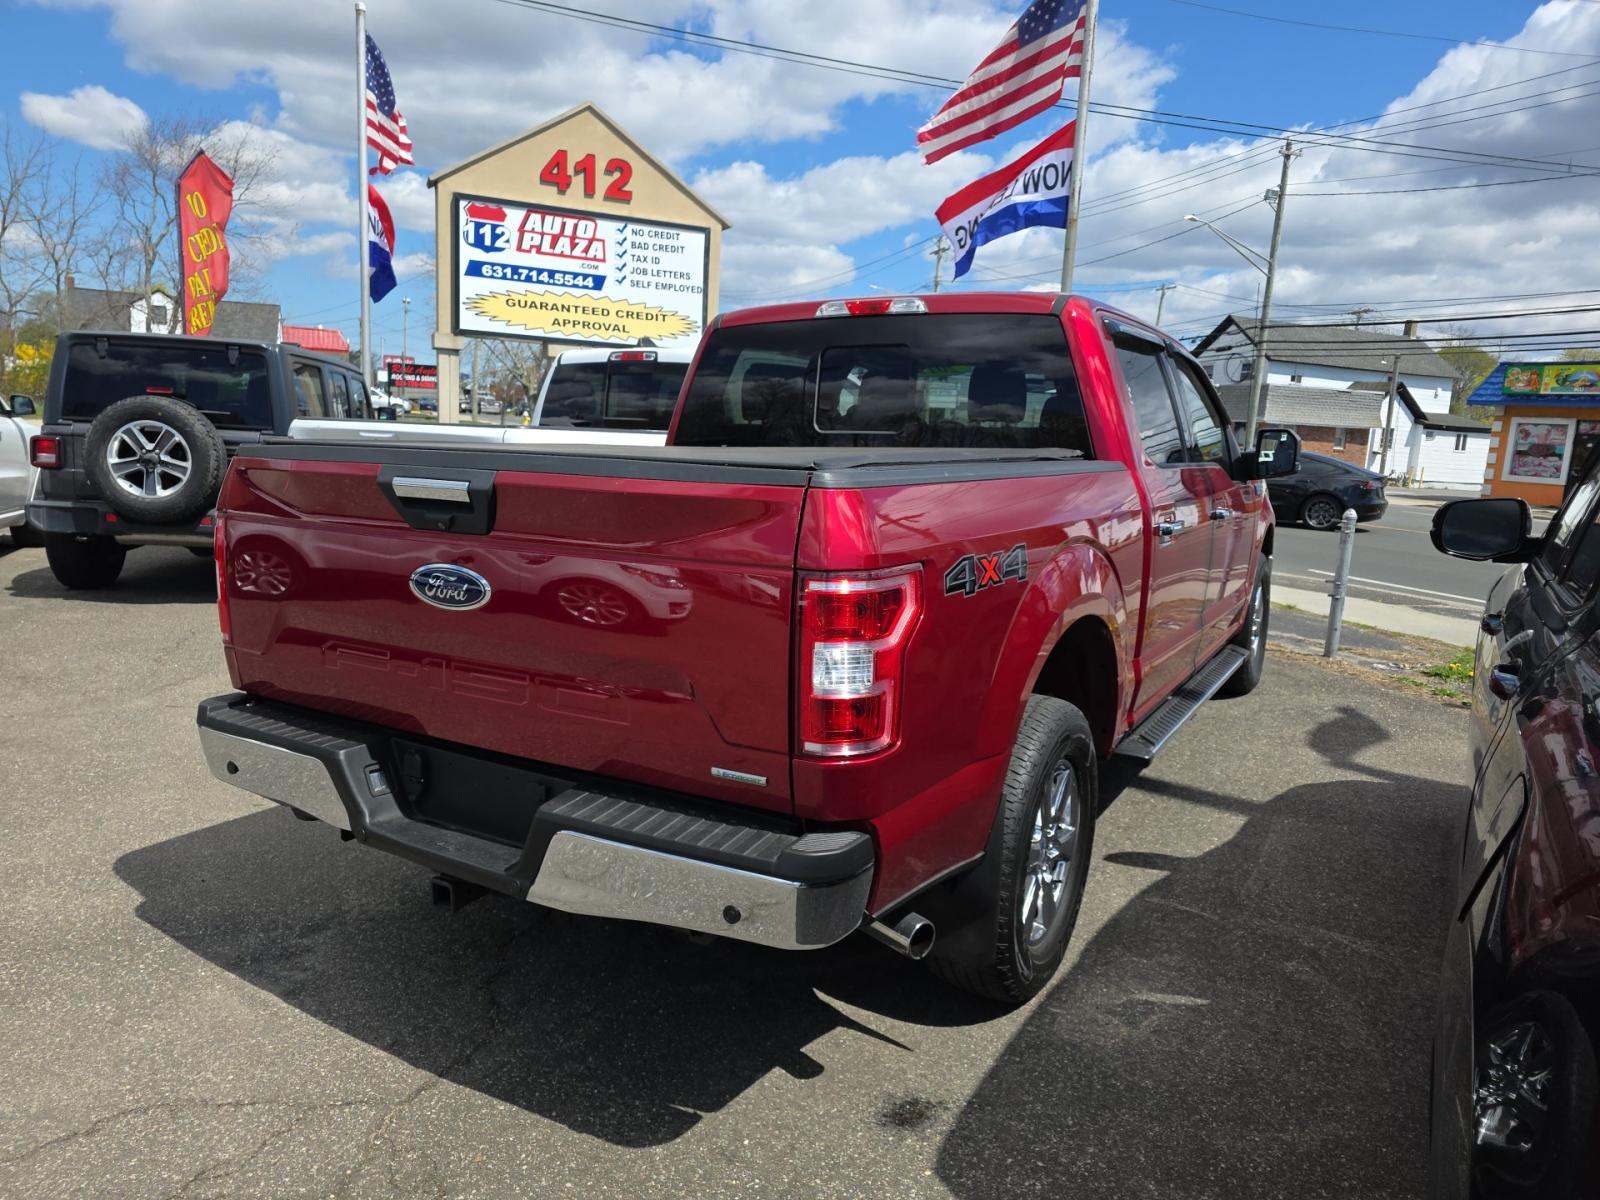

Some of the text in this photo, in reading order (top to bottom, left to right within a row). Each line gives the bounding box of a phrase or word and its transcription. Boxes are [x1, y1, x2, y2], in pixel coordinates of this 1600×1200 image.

[540, 149, 633, 204] 412
[463, 221, 511, 249] 112
[522, 212, 597, 240] AUTO
[631, 228, 680, 241] NO CREDIT
[520, 231, 602, 259] PLAZA
[631, 241, 685, 254] BAD CREDIT
[579, 262, 600, 271] .COM
[630, 254, 661, 265] TAX ID
[481, 264, 594, 288] 631.714.5544
[630, 267, 691, 281] JOB LETTERS
[630, 279, 703, 294] SELF EMPLOYED
[505, 297, 669, 322] GUARANTEED CREDIT
[551, 318, 630, 333] APPROVAL
[425, 573, 468, 600] Ford
